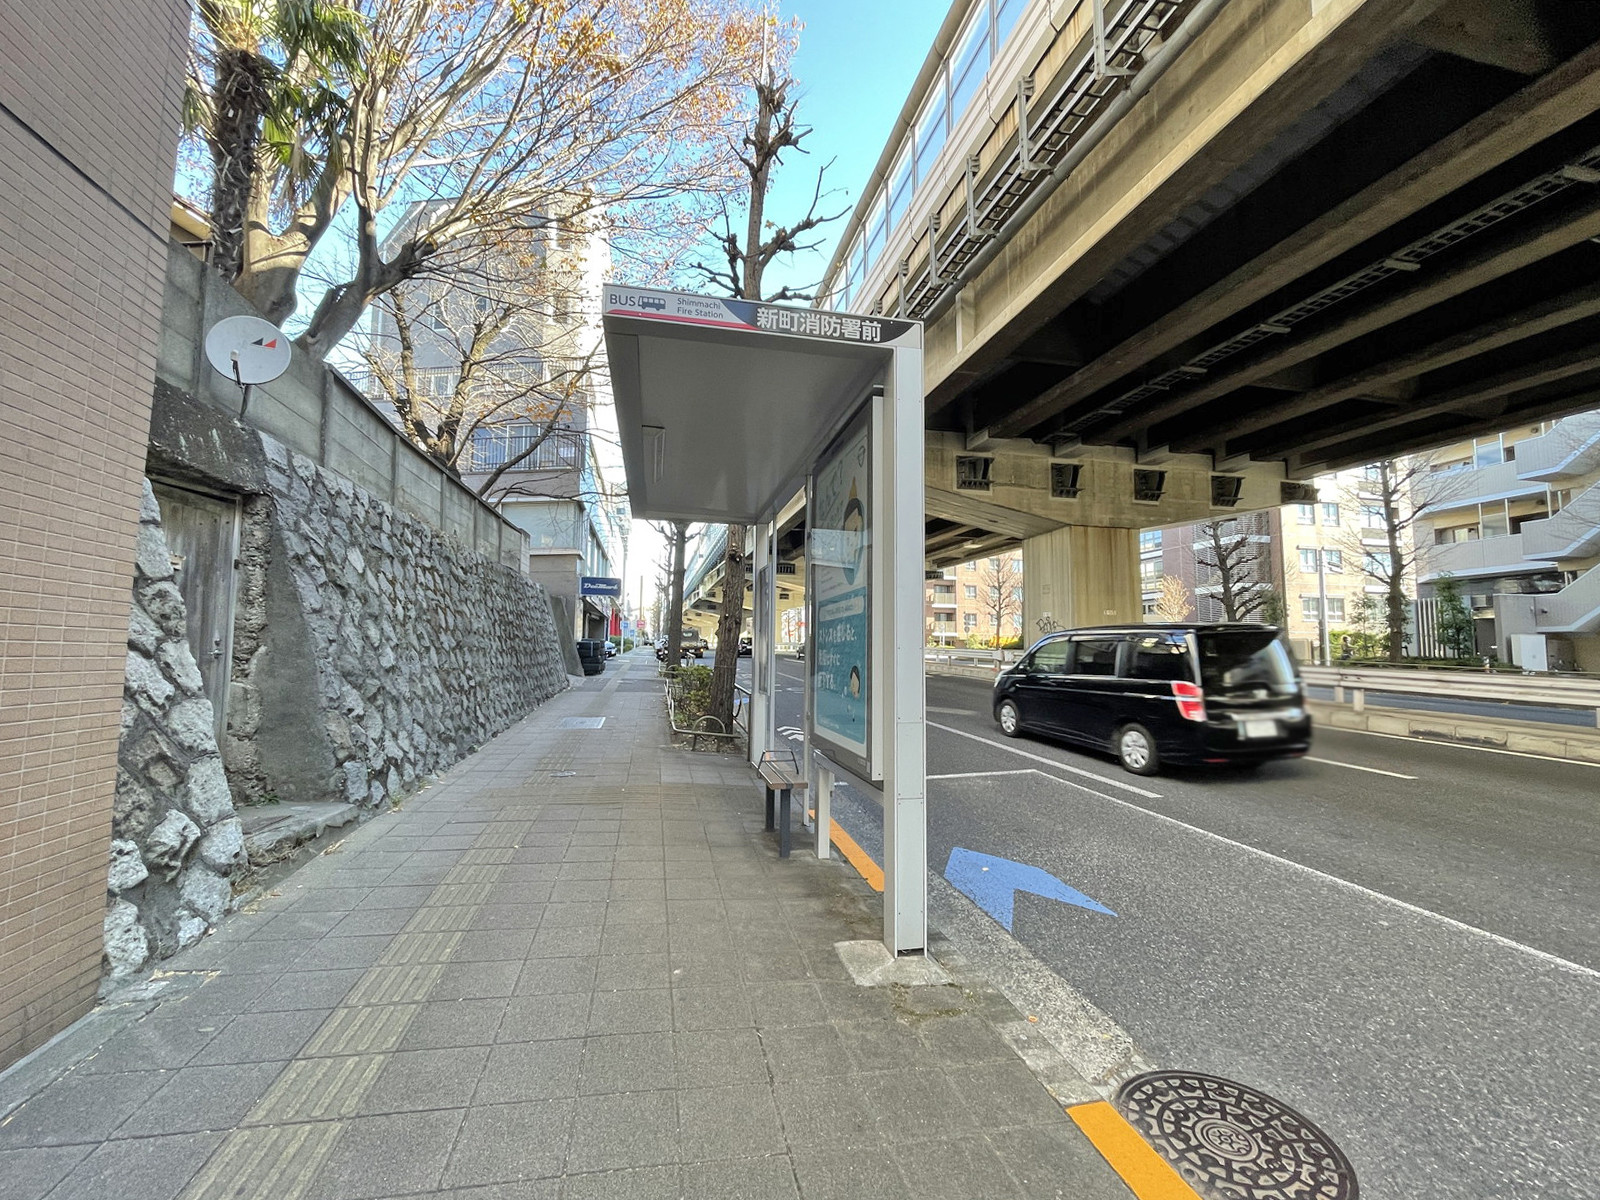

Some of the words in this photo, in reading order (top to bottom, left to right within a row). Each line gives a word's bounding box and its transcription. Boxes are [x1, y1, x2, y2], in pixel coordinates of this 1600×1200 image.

[609, 293, 636, 307] BUS
[677, 297, 721, 310] Shimmachi
[677, 308, 693, 316] Fire
[694, 309, 724, 319] Station
[756, 306, 882, 342] 新町消防署前
